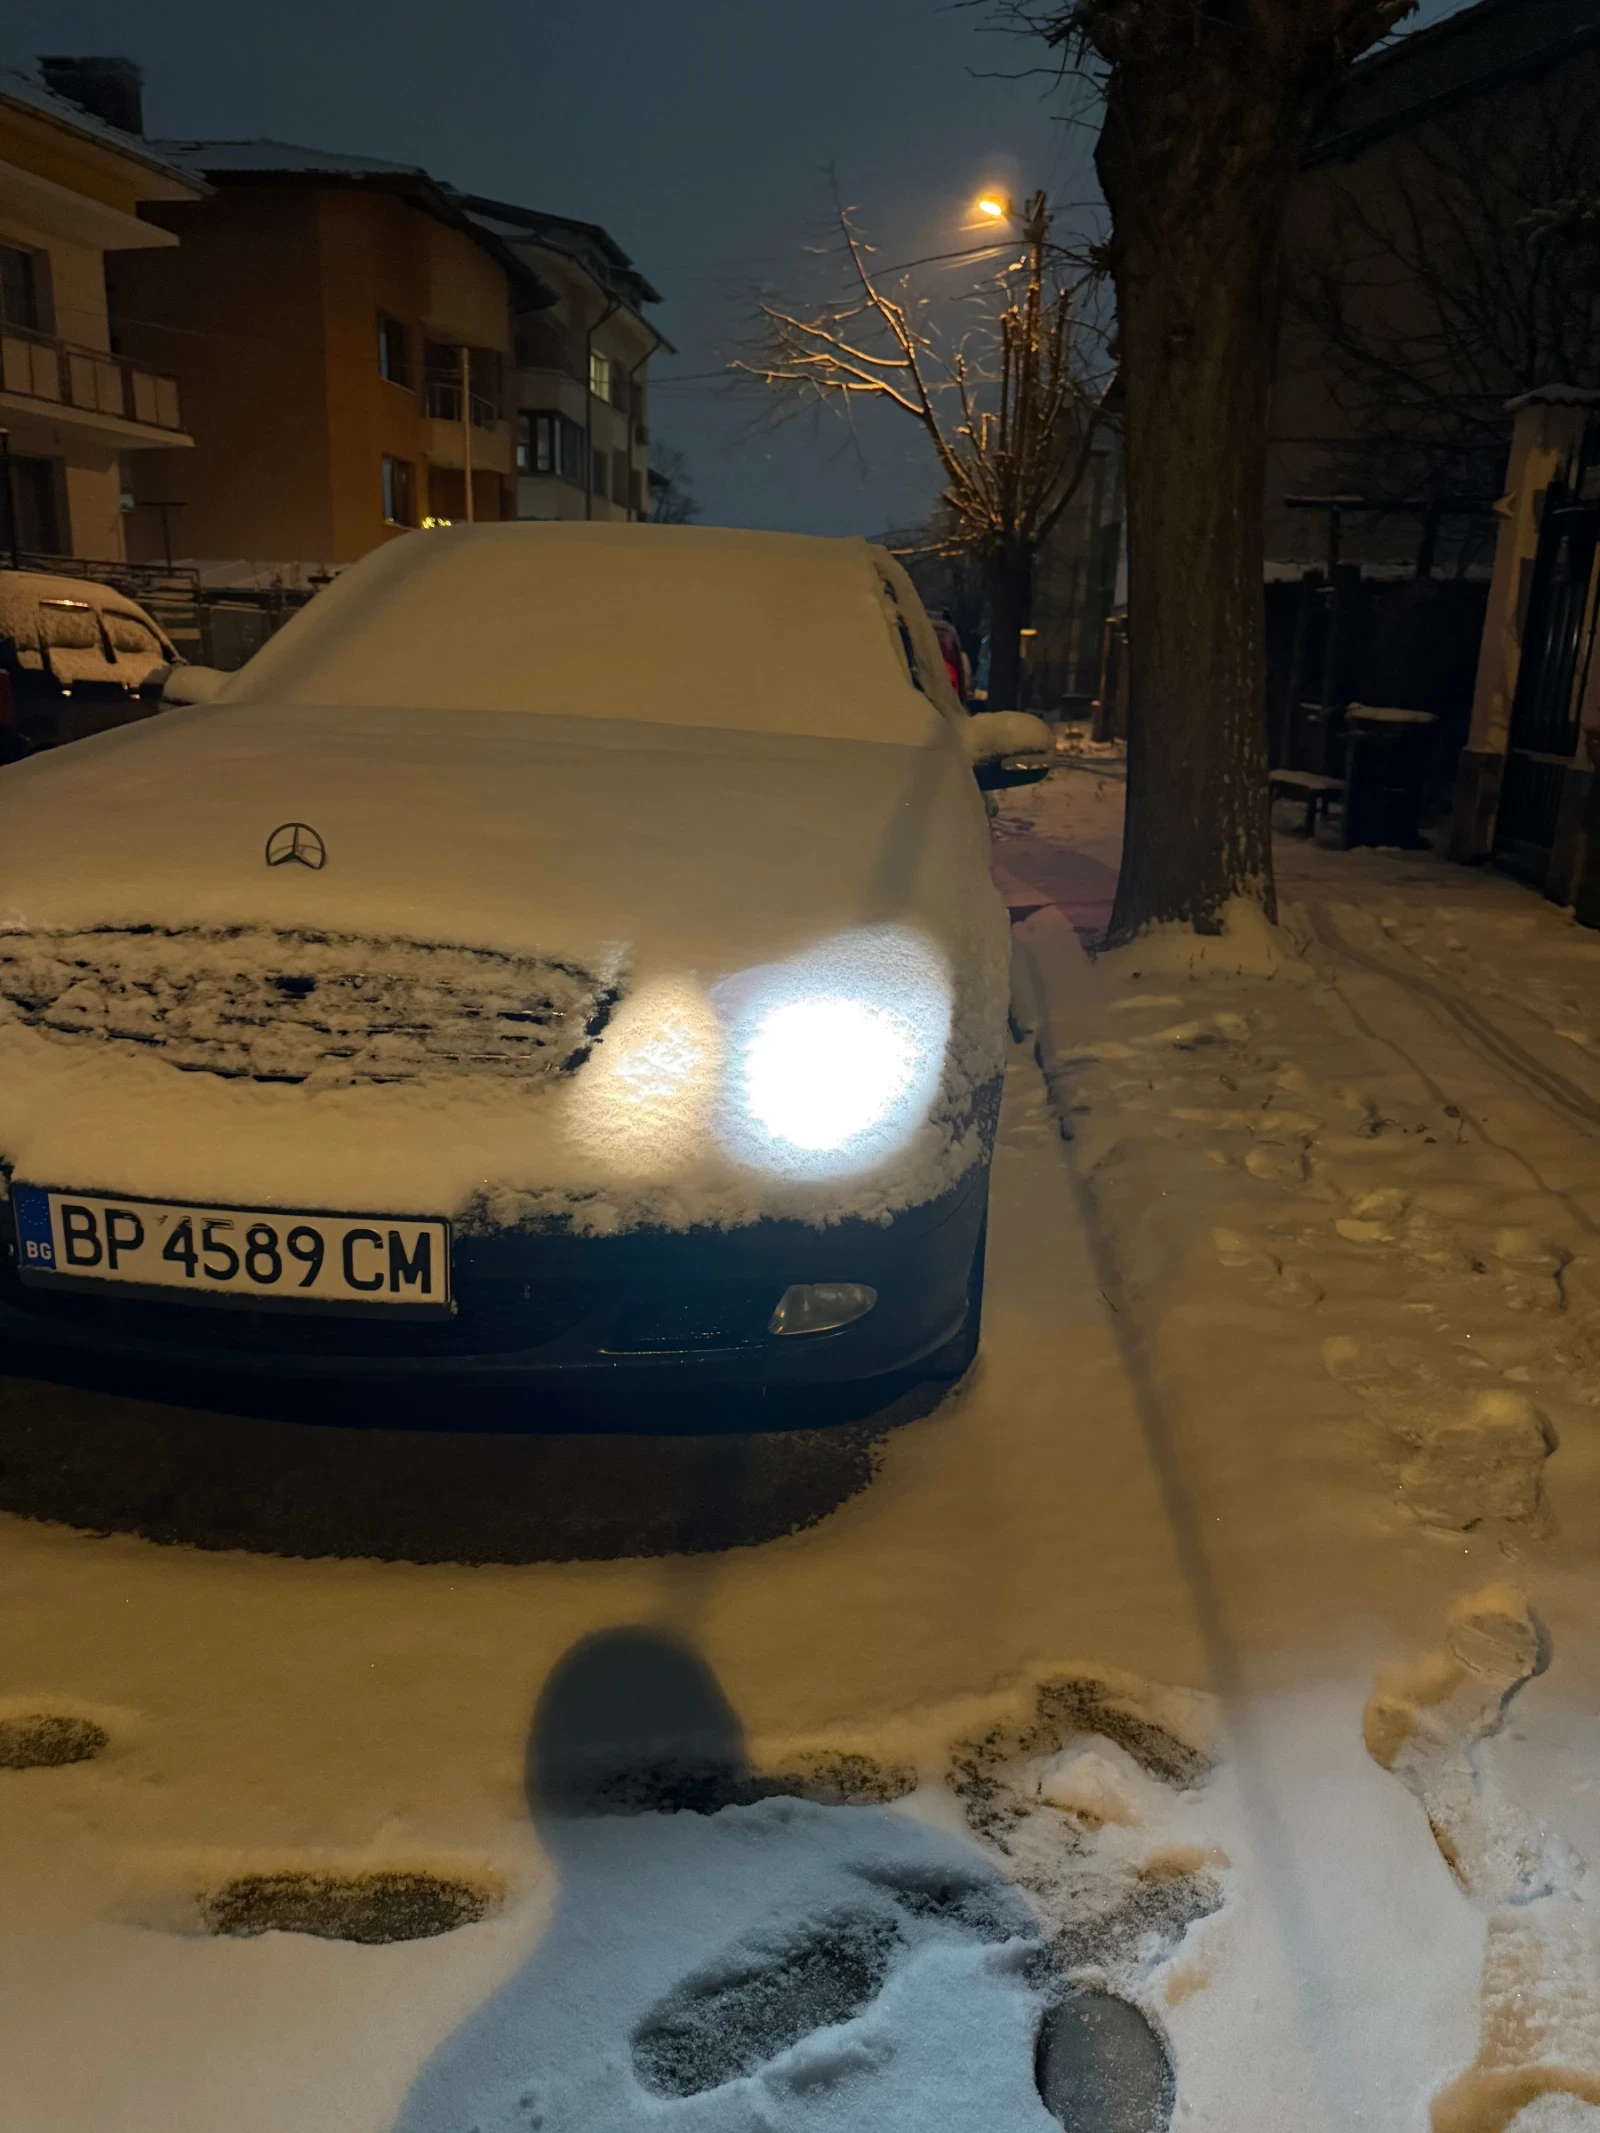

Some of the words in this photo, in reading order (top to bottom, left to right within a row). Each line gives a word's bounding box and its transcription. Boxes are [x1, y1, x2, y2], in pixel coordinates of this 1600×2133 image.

[26, 1240, 52, 1260] BG
[61, 1204, 144, 1270] BP
[163, 1216, 324, 1287] 4589
[342, 1228, 431, 1294] CM
